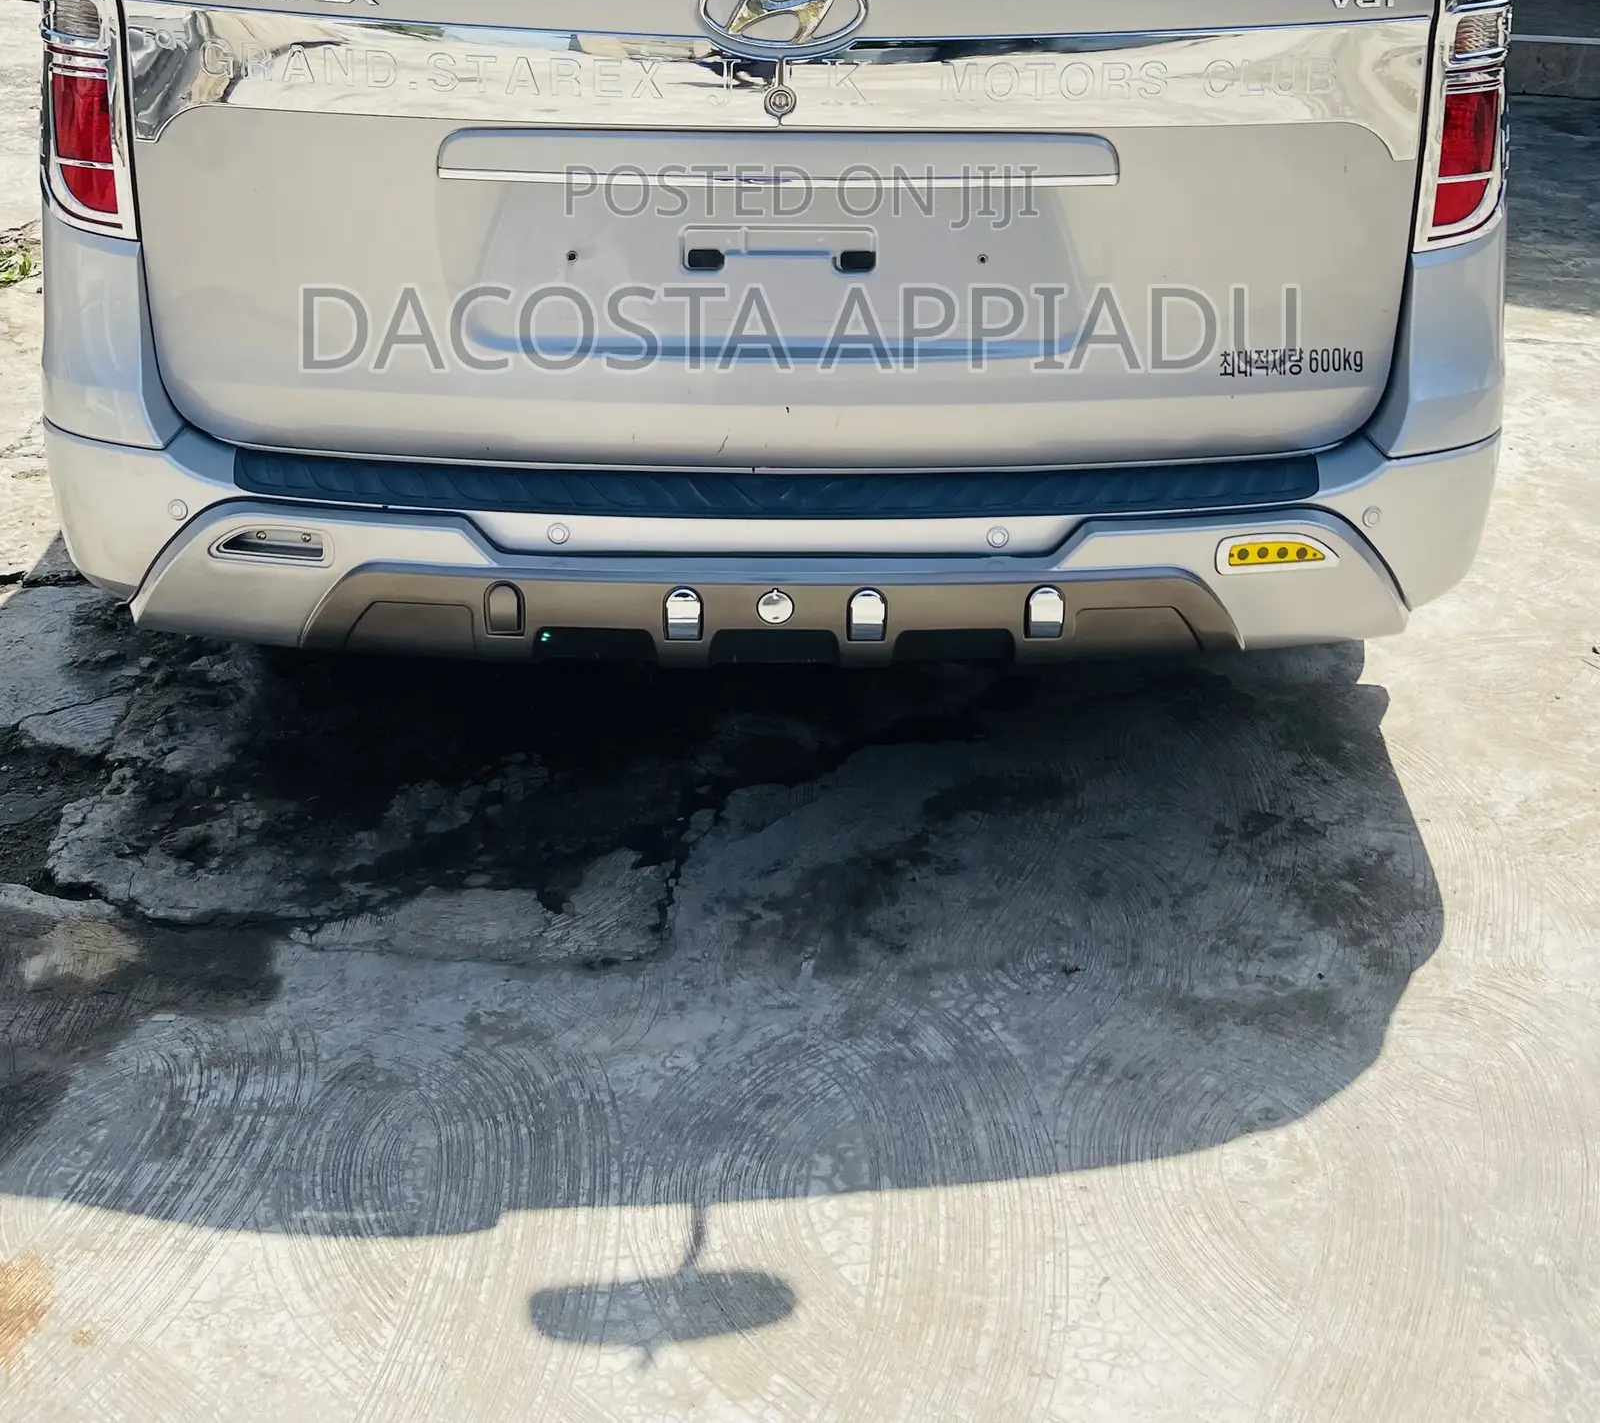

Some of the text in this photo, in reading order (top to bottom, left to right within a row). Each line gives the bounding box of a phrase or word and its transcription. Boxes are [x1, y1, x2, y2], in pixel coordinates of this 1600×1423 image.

[940, 60, 1169, 102] MOTORS
[1202, 55, 1338, 98] CLUB
[1219, 347, 1364, 377] 최대적재량 600kg
